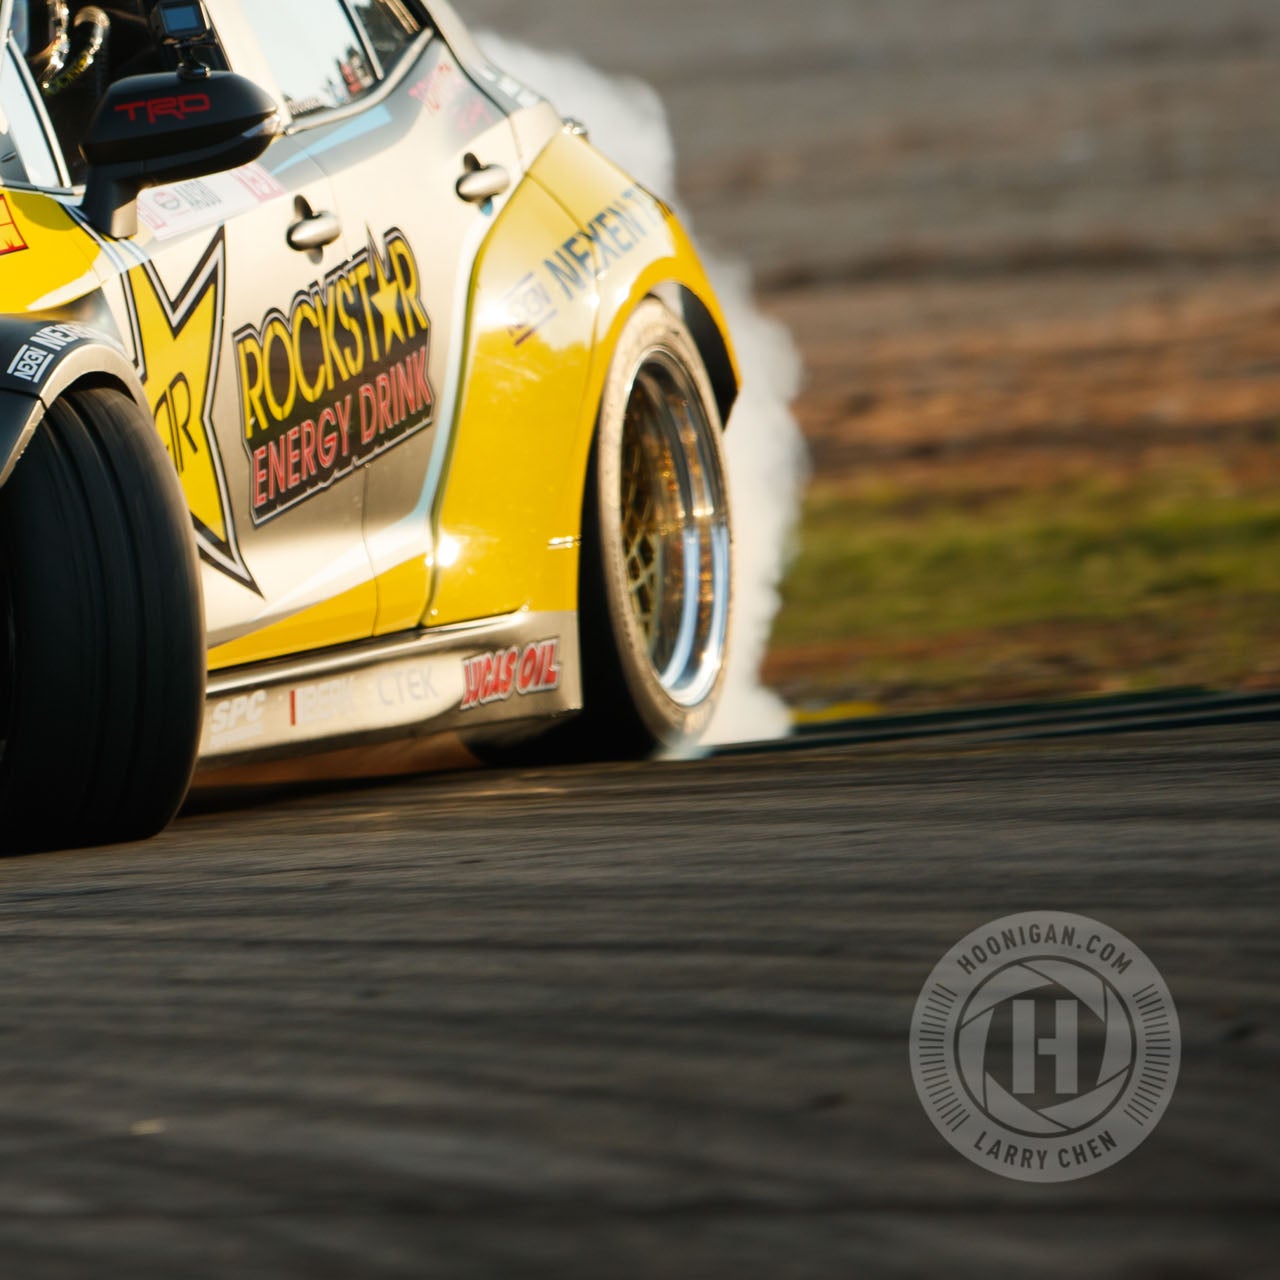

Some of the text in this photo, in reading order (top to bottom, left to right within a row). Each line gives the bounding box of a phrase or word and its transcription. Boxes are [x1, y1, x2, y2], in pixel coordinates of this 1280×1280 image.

[114, 93, 211, 125] TRD
[253, 345, 432, 508] ENERGY DRINK
[376, 662, 440, 708] CTEK
[461, 638, 560, 710] LUCAS OIL
